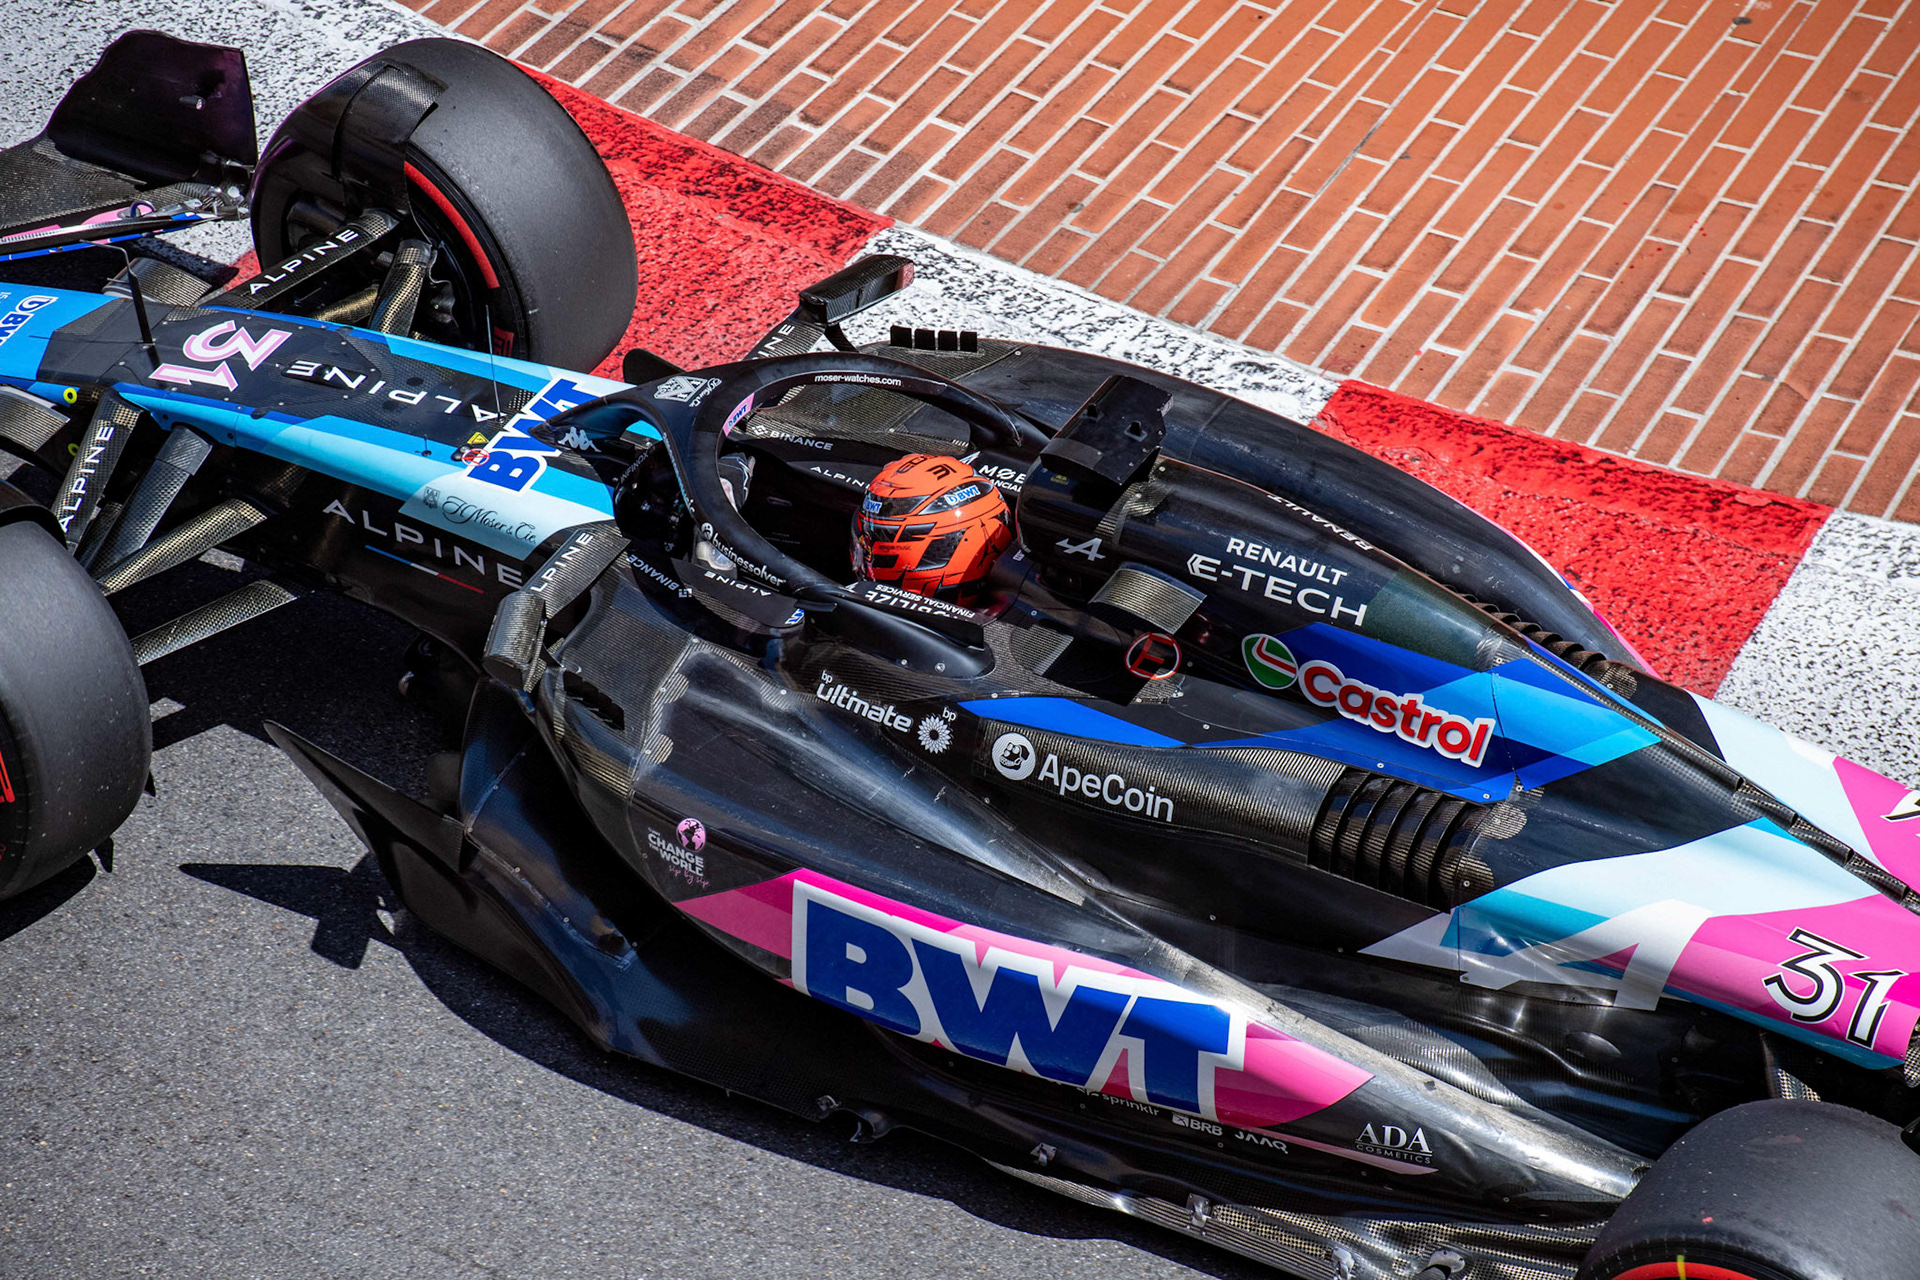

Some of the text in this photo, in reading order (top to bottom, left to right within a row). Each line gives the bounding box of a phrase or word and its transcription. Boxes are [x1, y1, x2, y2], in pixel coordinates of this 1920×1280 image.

[250, 229, 358, 294] ALPINE
[0, 311, 34, 346] BW
[752, 324, 795, 359] INE
[149, 320, 292, 391] 31
[287, 359, 507, 423] ALPINE
[814, 373, 902, 386] moser-watches.com
[465, 376, 601, 494] BWT
[770, 431, 833, 450] BINANCE
[58, 425, 114, 532] ALPINE
[810, 466, 870, 491] ALPIN
[957, 485, 981, 502] BWT
[865, 501, 882, 514] BWT
[1268, 494, 1374, 551] RENAULT
[322, 499, 524, 591] ALPINE
[530, 532, 594, 593] LPINE
[713, 532, 785, 587] businessolver
[1226, 537, 1348, 586] RENAULT
[627, 553, 681, 591] BINANCE
[703, 570, 772, 597] ALPINE
[1187, 553, 1368, 627] E-TECH
[875, 584, 975, 618] FINANCIAL SERVICES
[820, 669, 834, 684] bp
[816, 682, 914, 734] ultimate
[942, 706, 957, 722] bp
[1301, 663, 1493, 765] Castrol
[1037, 753, 1175, 823] ApeCoin
[648, 833, 704, 868] CHANGE
[796, 883, 1243, 1119] BWT
[1762, 926, 1908, 1050] 31
[1102, 1092, 1160, 1117] sprinklr
[1189, 1117, 1223, 1137] BRB
[1355, 1122, 1434, 1155] ADA
[1355, 1143, 1432, 1165] COSMETICS
